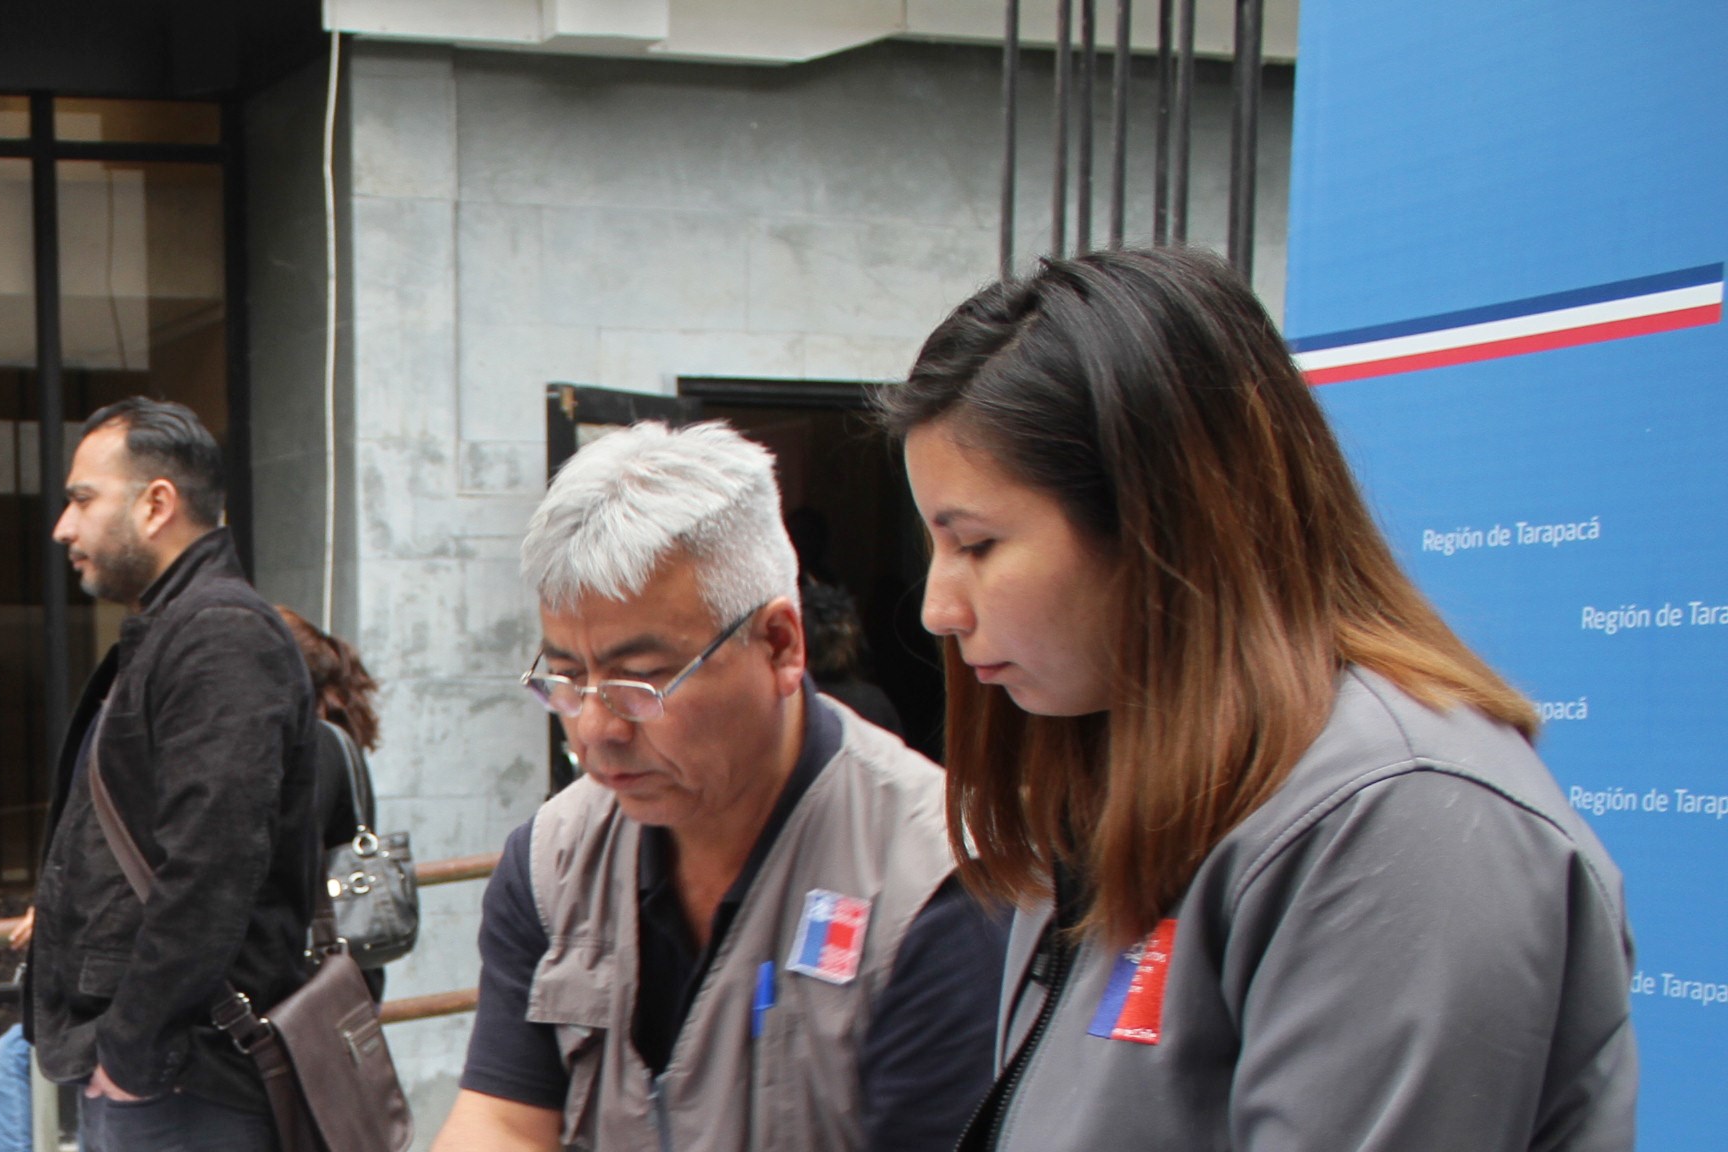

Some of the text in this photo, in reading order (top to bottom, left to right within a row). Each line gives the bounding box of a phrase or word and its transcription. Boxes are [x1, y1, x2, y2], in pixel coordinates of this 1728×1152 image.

[1423, 515, 1601, 556] Región de Tarapacá
[1581, 604, 1651, 635] Región
[1655, 602, 1684, 628] de
[1569, 785, 1638, 817] Región
[1642, 788, 1669, 813] de
[1631, 971, 1656, 995] de
